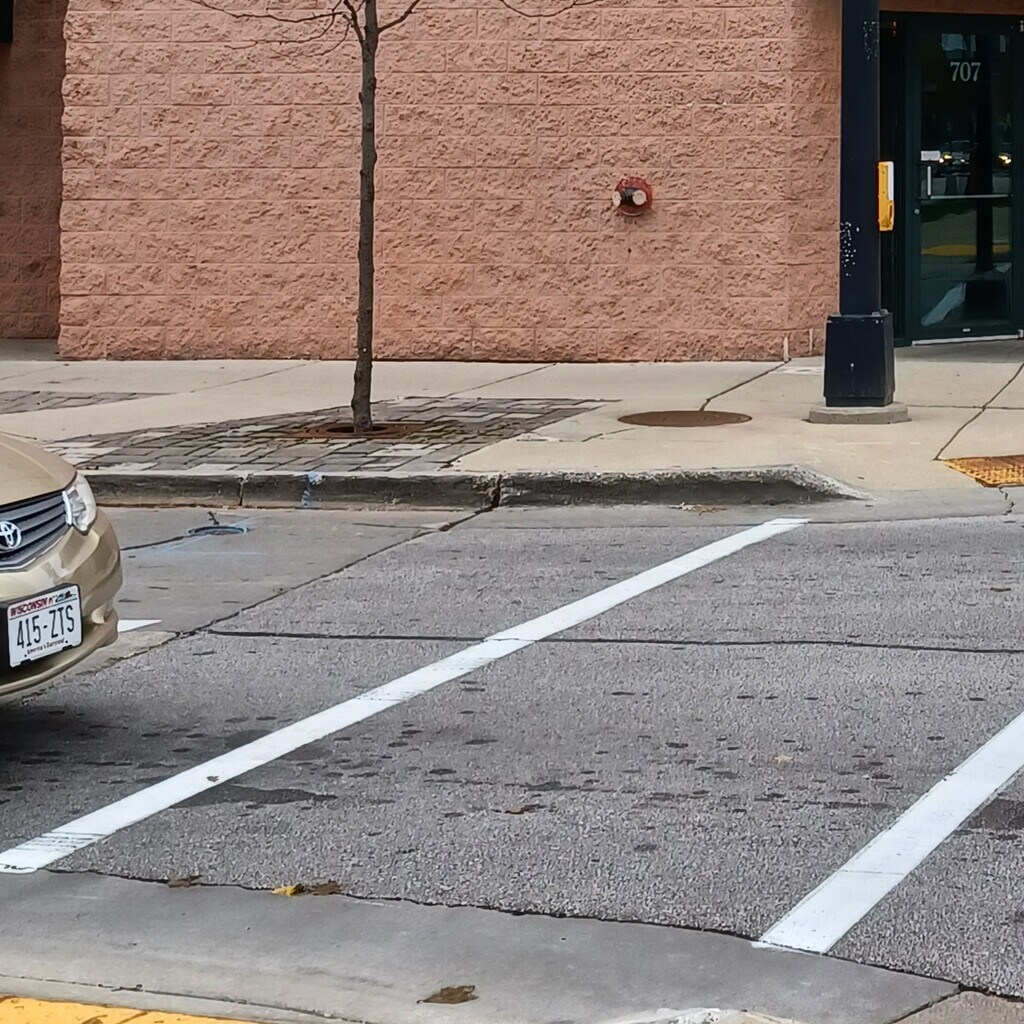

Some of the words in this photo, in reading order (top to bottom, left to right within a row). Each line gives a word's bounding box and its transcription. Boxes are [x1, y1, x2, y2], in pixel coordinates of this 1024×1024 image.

[950, 61, 981, 82] 707
[10, 597, 48, 616] WISCONSIN
[17, 604, 75, 649] 415-ZTS
